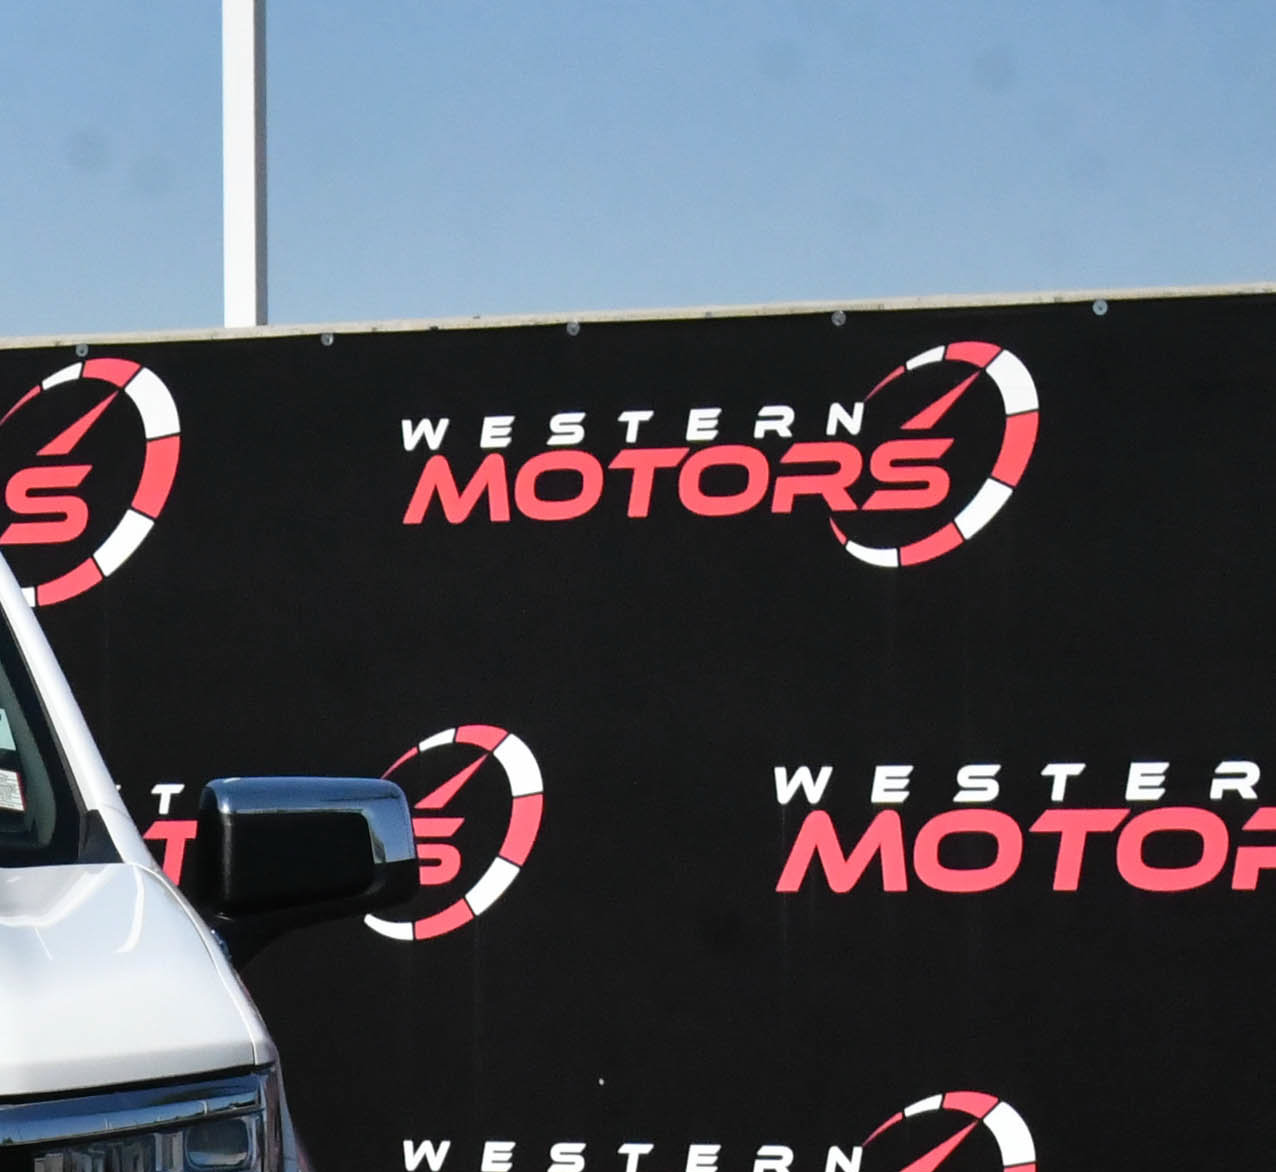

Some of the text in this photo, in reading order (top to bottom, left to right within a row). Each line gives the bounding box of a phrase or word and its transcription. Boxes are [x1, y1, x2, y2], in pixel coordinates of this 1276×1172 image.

[401, 402, 865, 453] WESTERN
[403, 437, 955, 525] MOTORS
[774, 761, 1262, 806] WESTER
